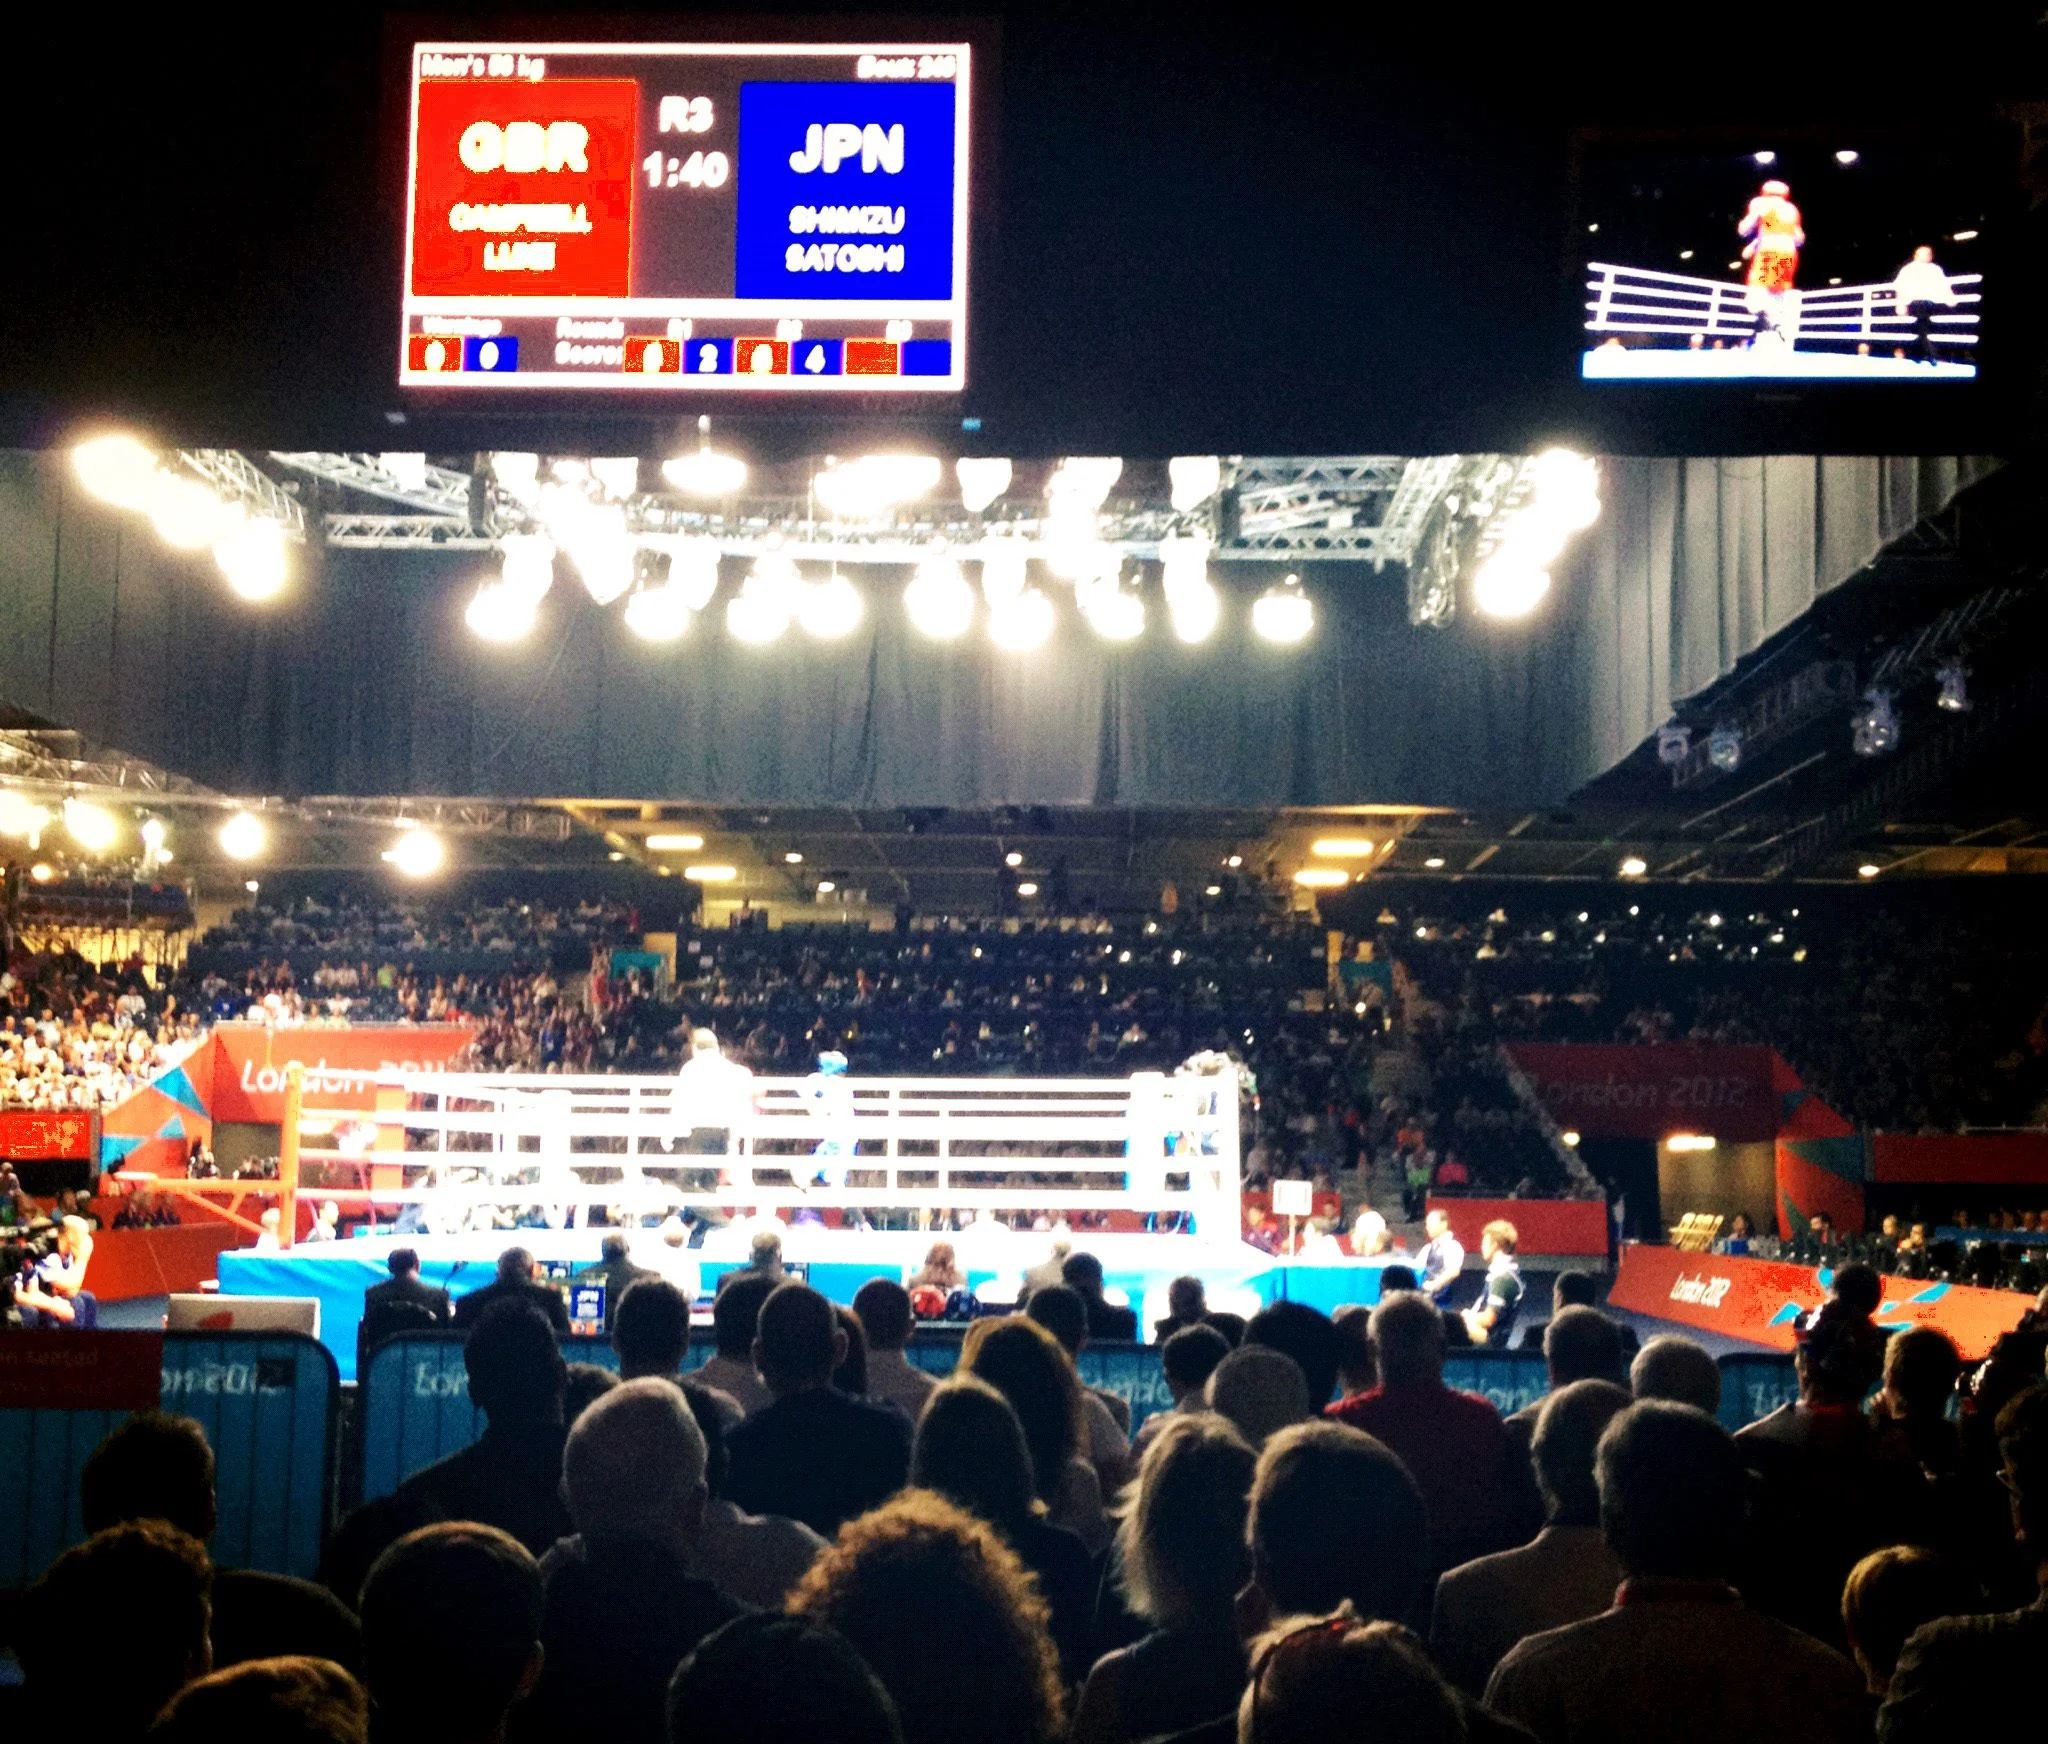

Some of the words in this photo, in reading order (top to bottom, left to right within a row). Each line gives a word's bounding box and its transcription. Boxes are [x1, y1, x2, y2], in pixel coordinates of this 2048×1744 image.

[659, 95, 714, 133] R3
[458, 121, 590, 173] GBR
[789, 123, 905, 174] JPN
[642, 150, 729, 188] 1:40
[785, 243, 905, 273] SATOSHI
[479, 341, 500, 371] 0
[698, 343, 719, 373] 2
[803, 344, 826, 374] 4
[1542, 1071, 1659, 1108] ondon
